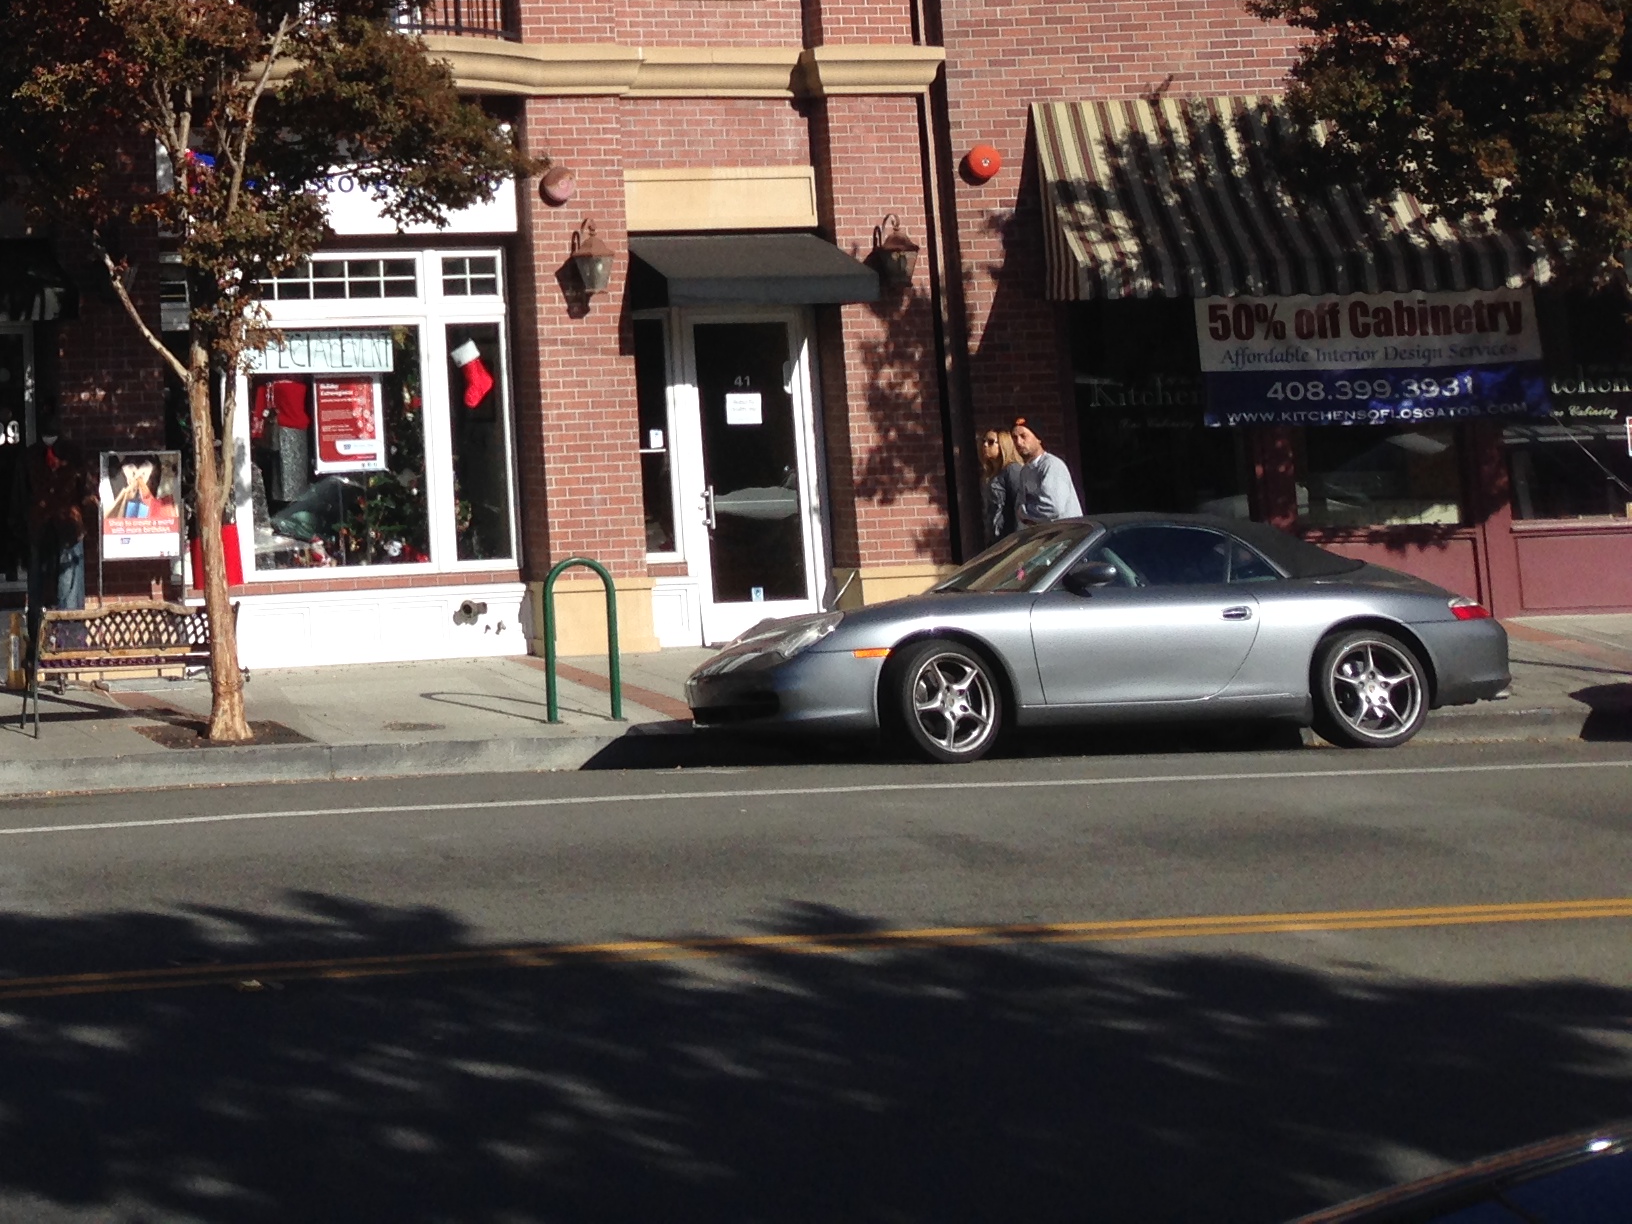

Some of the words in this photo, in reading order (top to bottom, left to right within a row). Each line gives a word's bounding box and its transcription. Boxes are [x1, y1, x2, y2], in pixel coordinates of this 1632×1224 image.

[1208, 302, 1286, 341] 50%
[1295, 301, 1341, 340] off
[1348, 299, 1523, 339] Cabinetry
[1221, 344, 1309, 369] Affordable
[1315, 345, 1378, 362] Interior
[1383, 344, 1442, 366] Design
[1449, 341, 1517, 359] Services
[734, 375, 751, 388] 41
[1266, 375, 1474, 401] 408.399.3931
